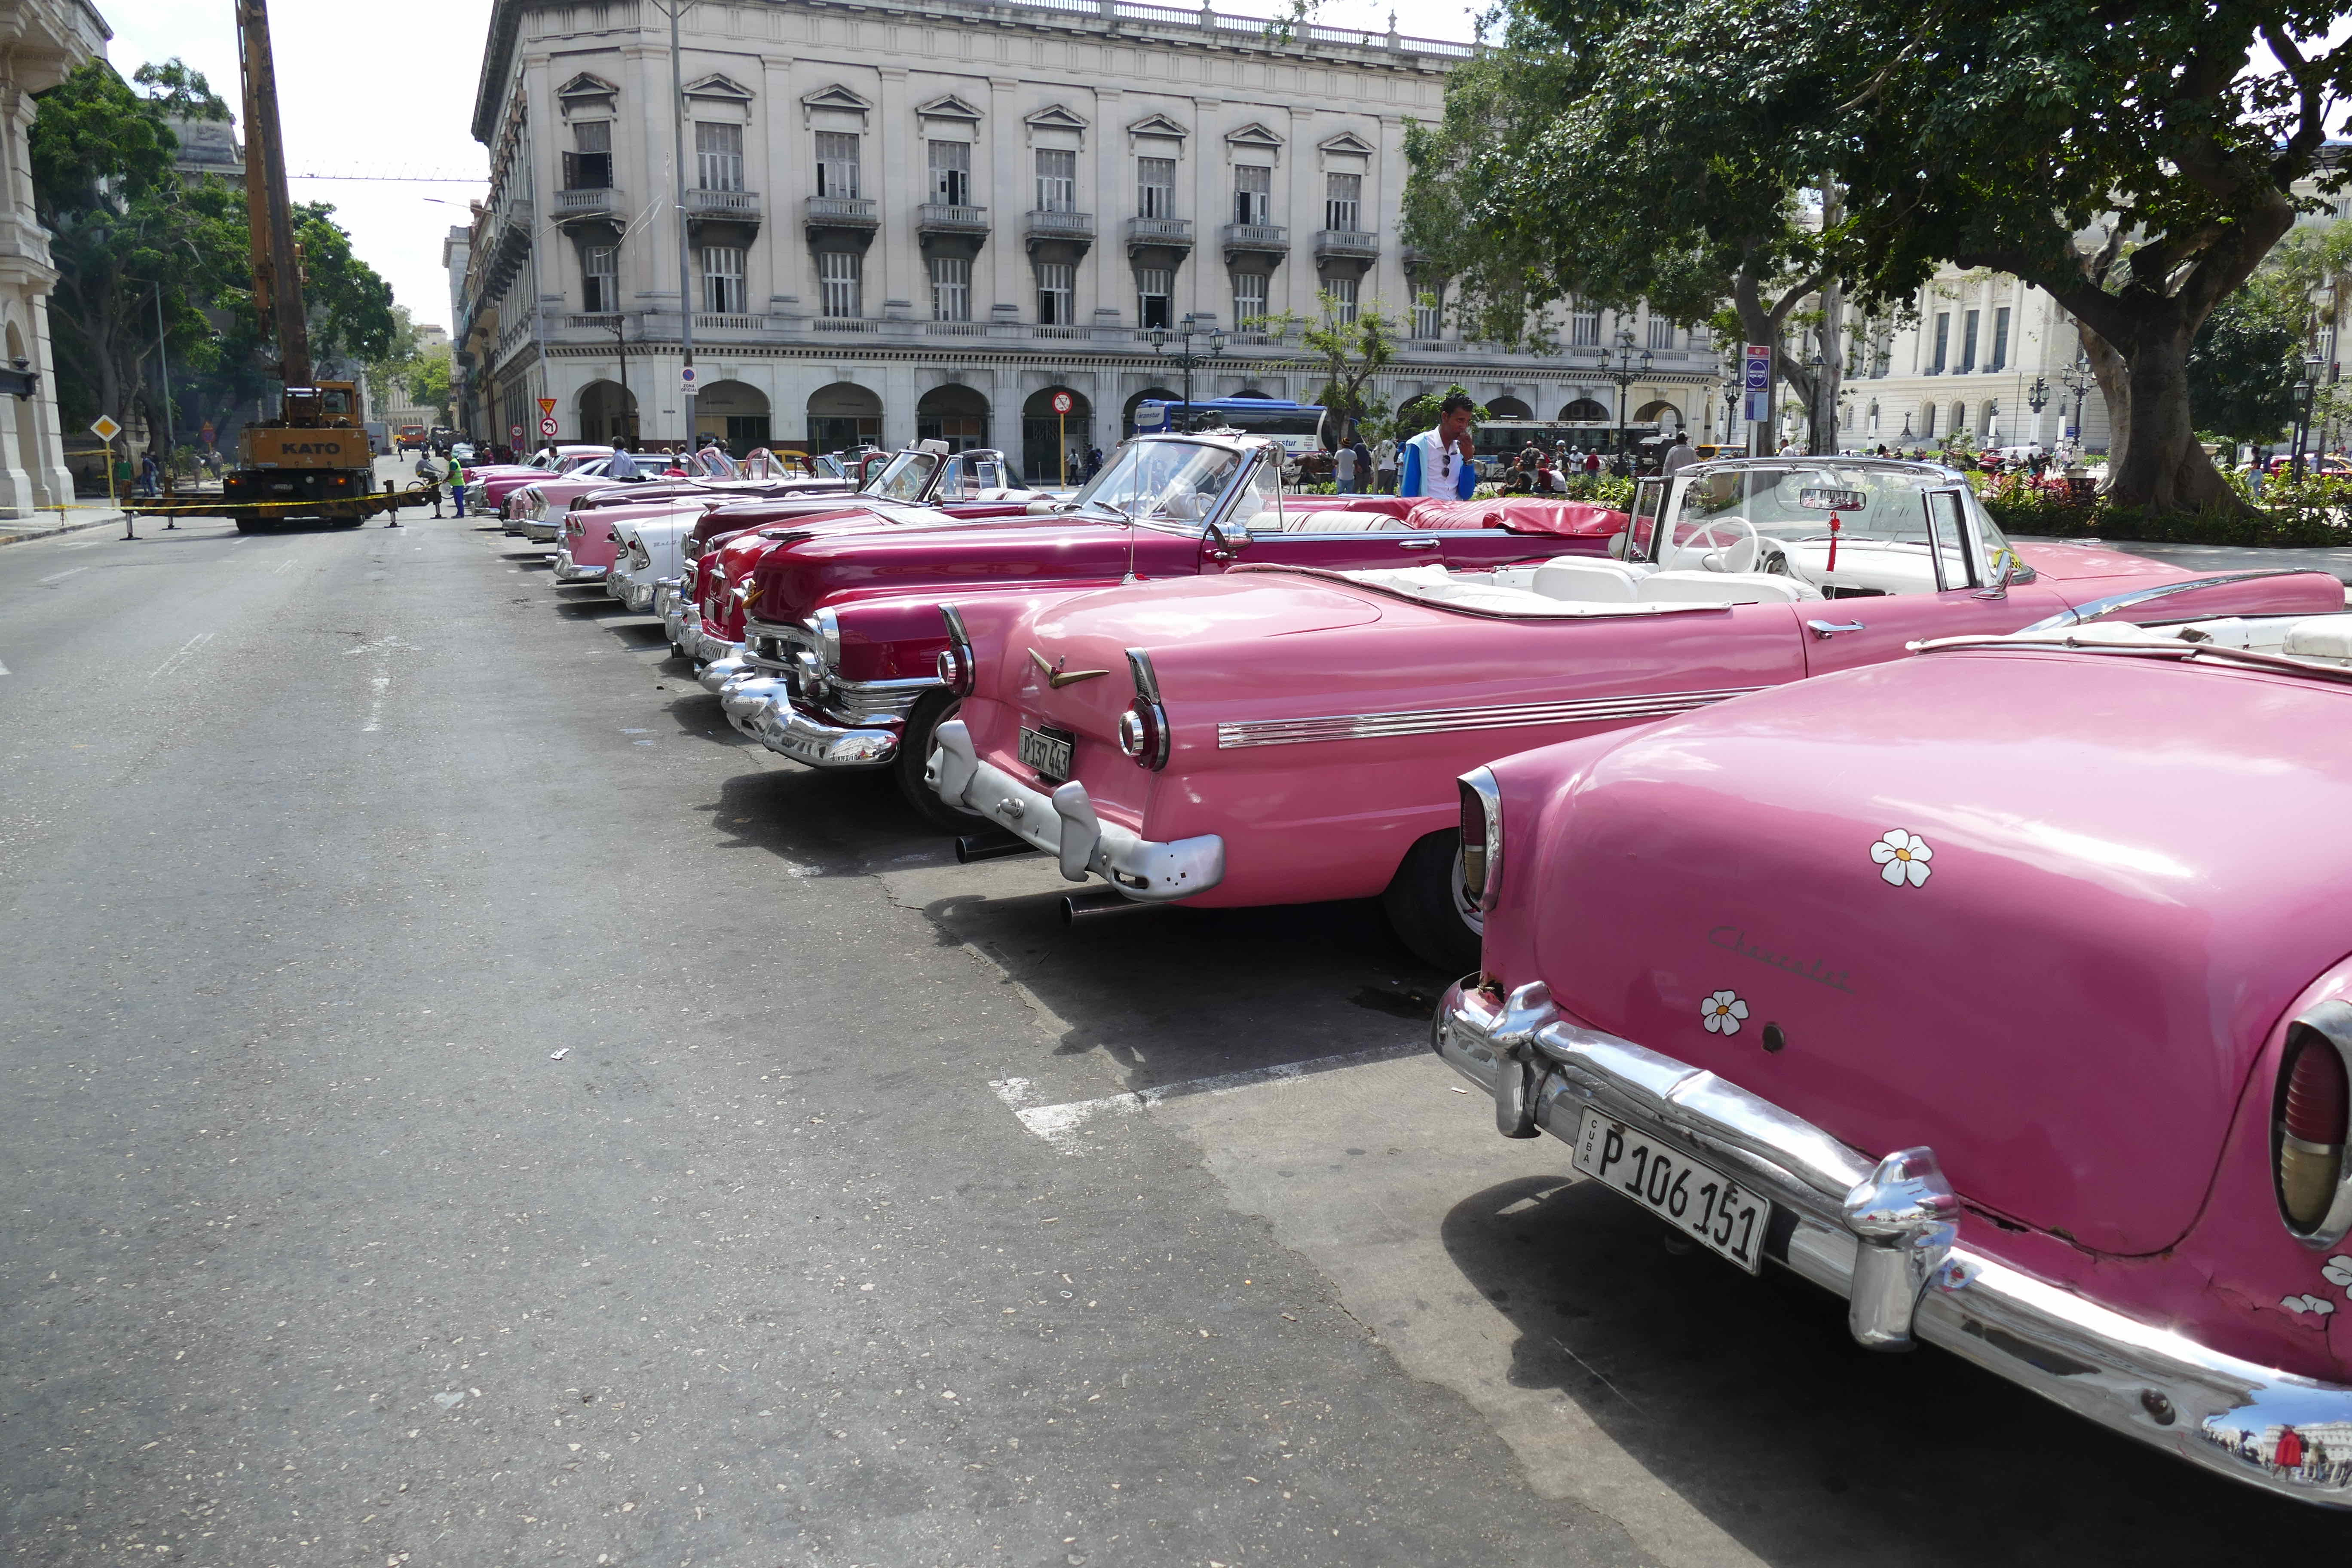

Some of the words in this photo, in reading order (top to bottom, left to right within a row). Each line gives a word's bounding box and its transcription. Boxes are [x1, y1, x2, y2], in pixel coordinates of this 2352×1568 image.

[282, 443, 340, 454] KATO
[1708, 926, 1855, 995] Chevrolet
[1583, 1120, 1598, 1164] CUBA
